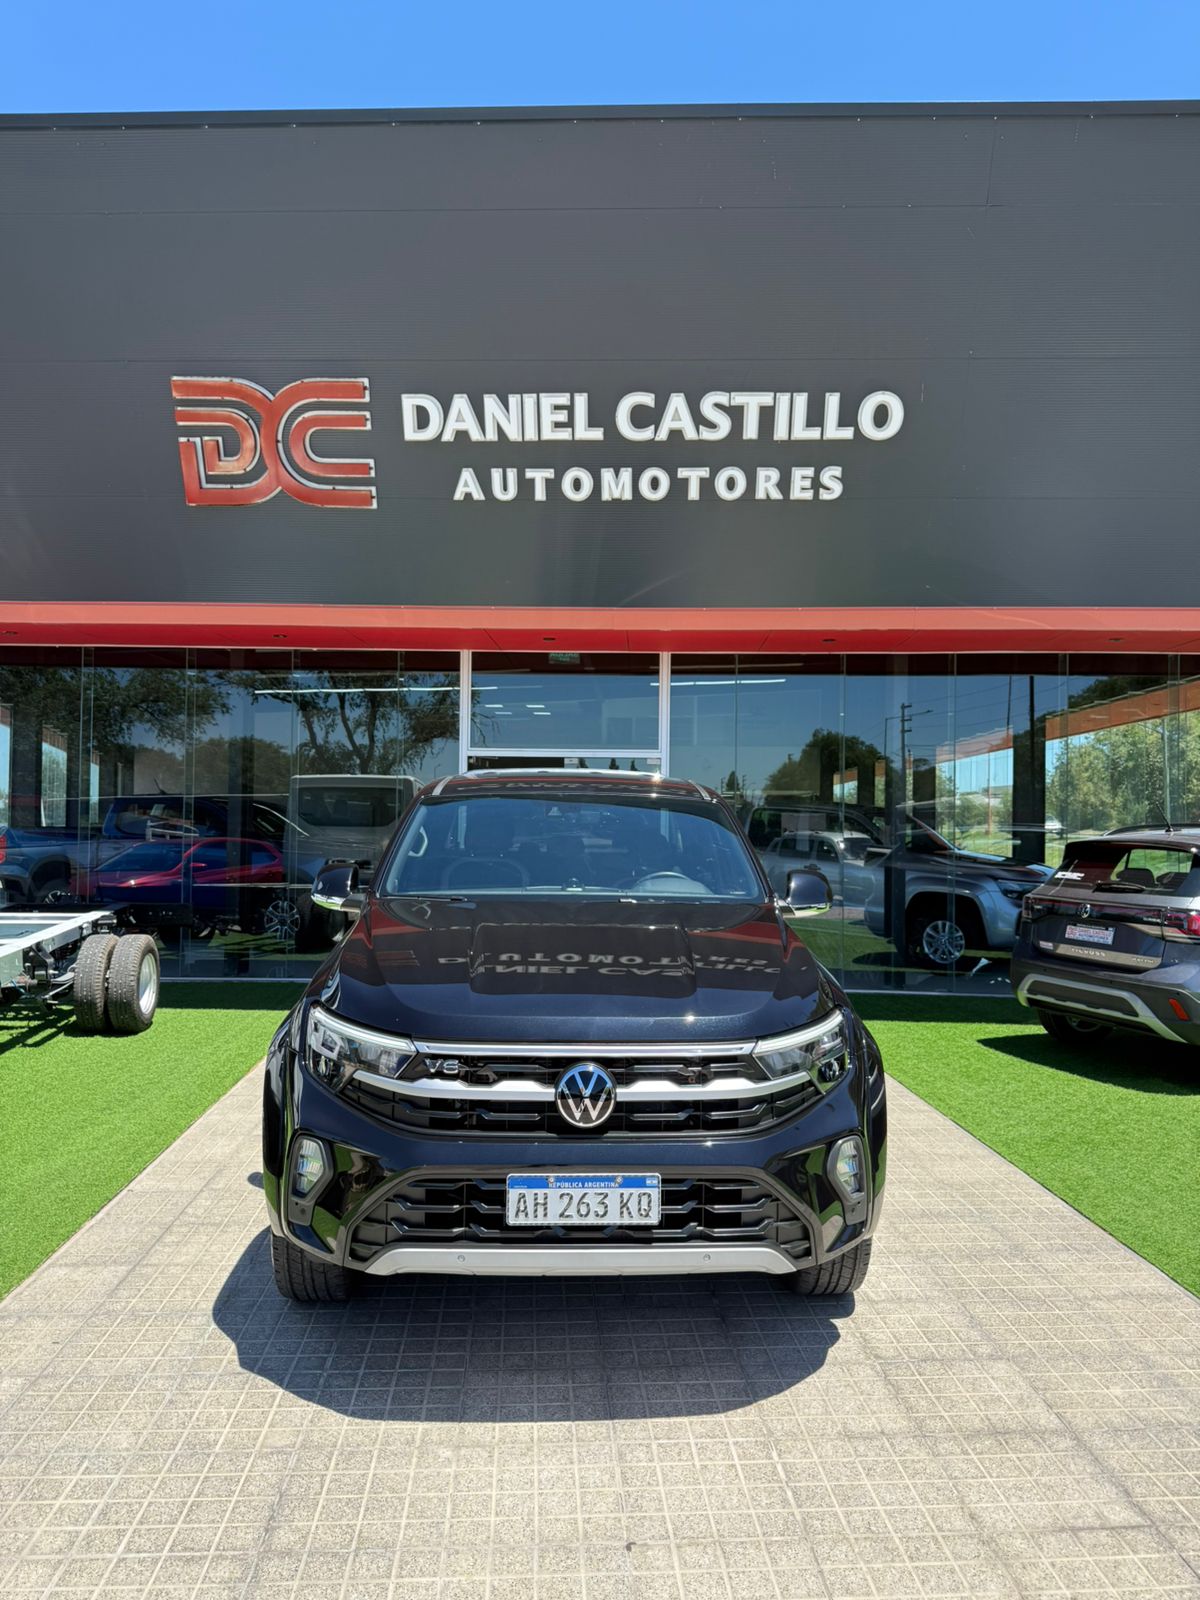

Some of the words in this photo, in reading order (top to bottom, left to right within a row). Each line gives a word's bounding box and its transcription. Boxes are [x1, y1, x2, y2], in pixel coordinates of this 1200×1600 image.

[401, 392, 604, 443] DANIEL
[615, 390, 905, 442] CASTILLO
[171, 376, 378, 510] DC
[453, 465, 844, 502] AUTOMOTORES
[424, 1059, 459, 1074] V6
[514, 1192, 548, 1219] AH
[558, 1192, 609, 1219] 263
[619, 1192, 653, 1219] KQ
